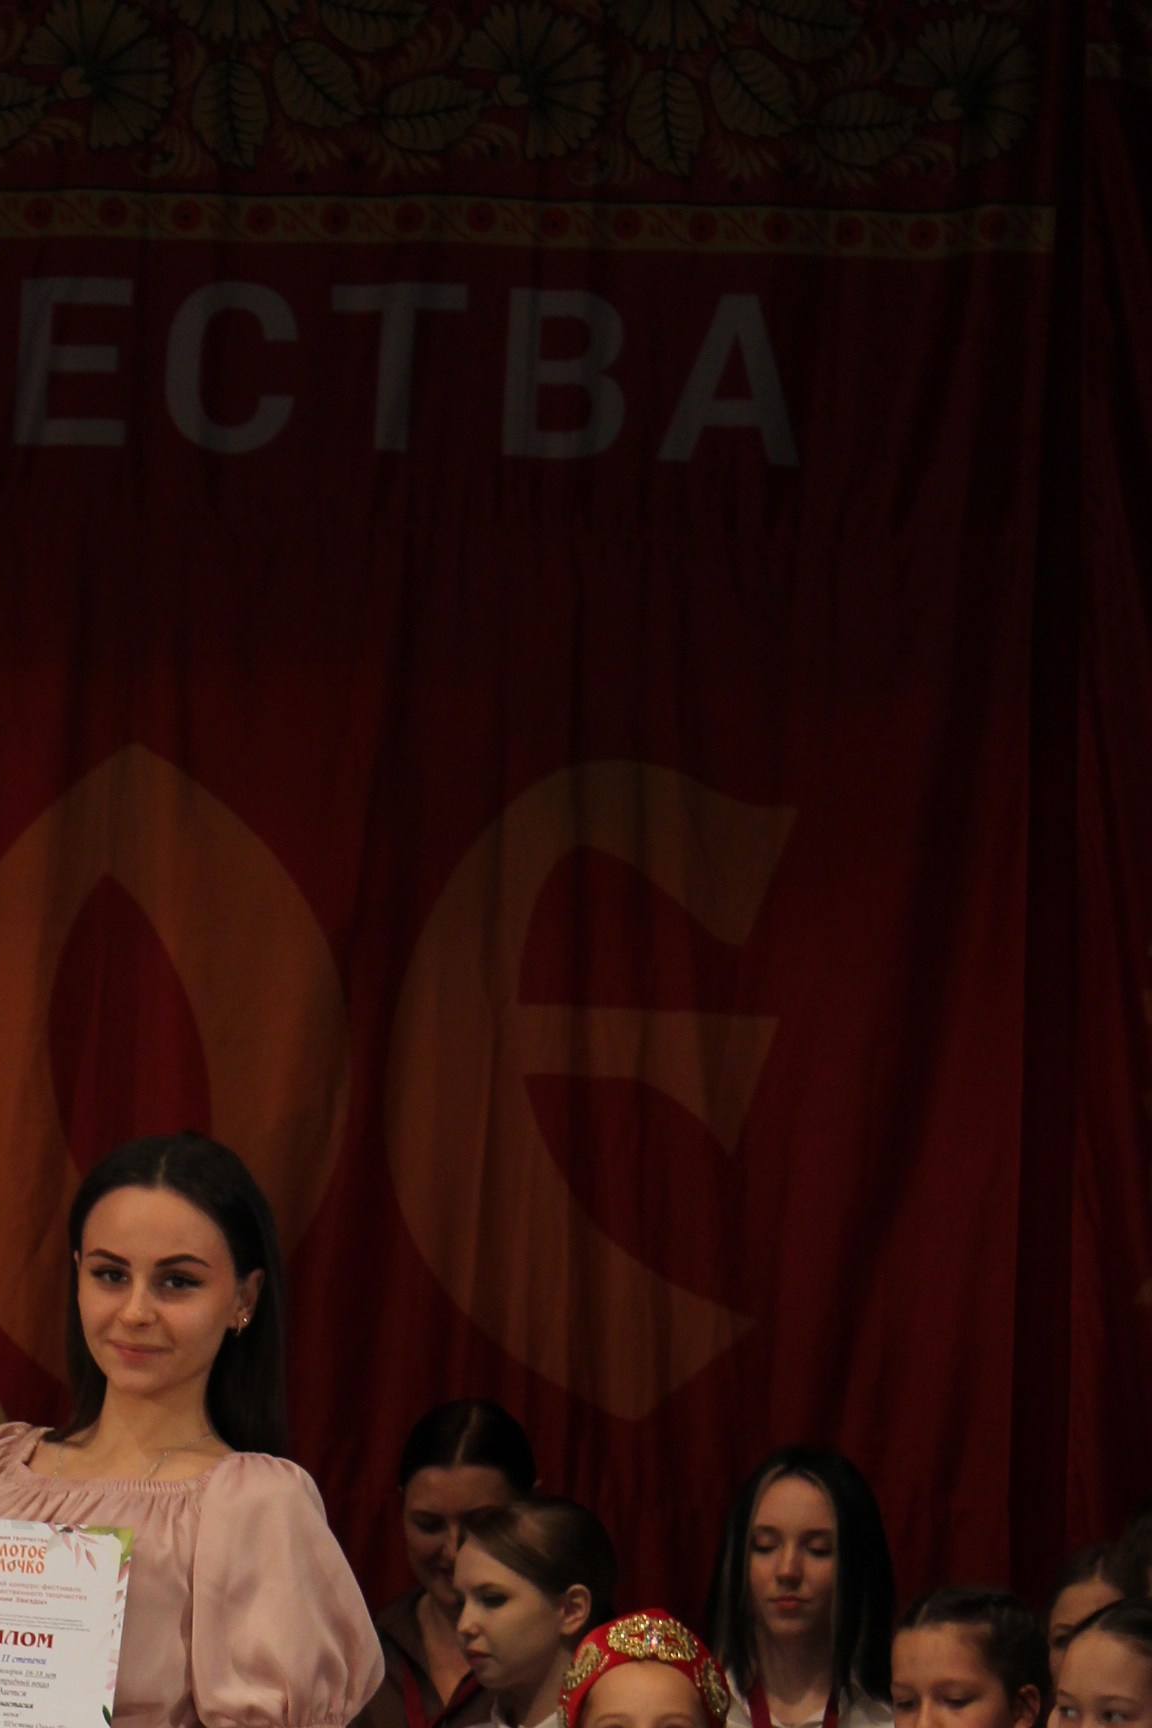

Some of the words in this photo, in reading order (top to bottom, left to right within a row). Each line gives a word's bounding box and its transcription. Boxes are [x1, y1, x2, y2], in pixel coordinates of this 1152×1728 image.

[13, 1536, 47, 1544] ТВОРЧЕСТВА
[45, 1592, 87, 1602] творчества
[1, 1653, 10, 1663] II
[12, 1655, 47, 1665] степени
